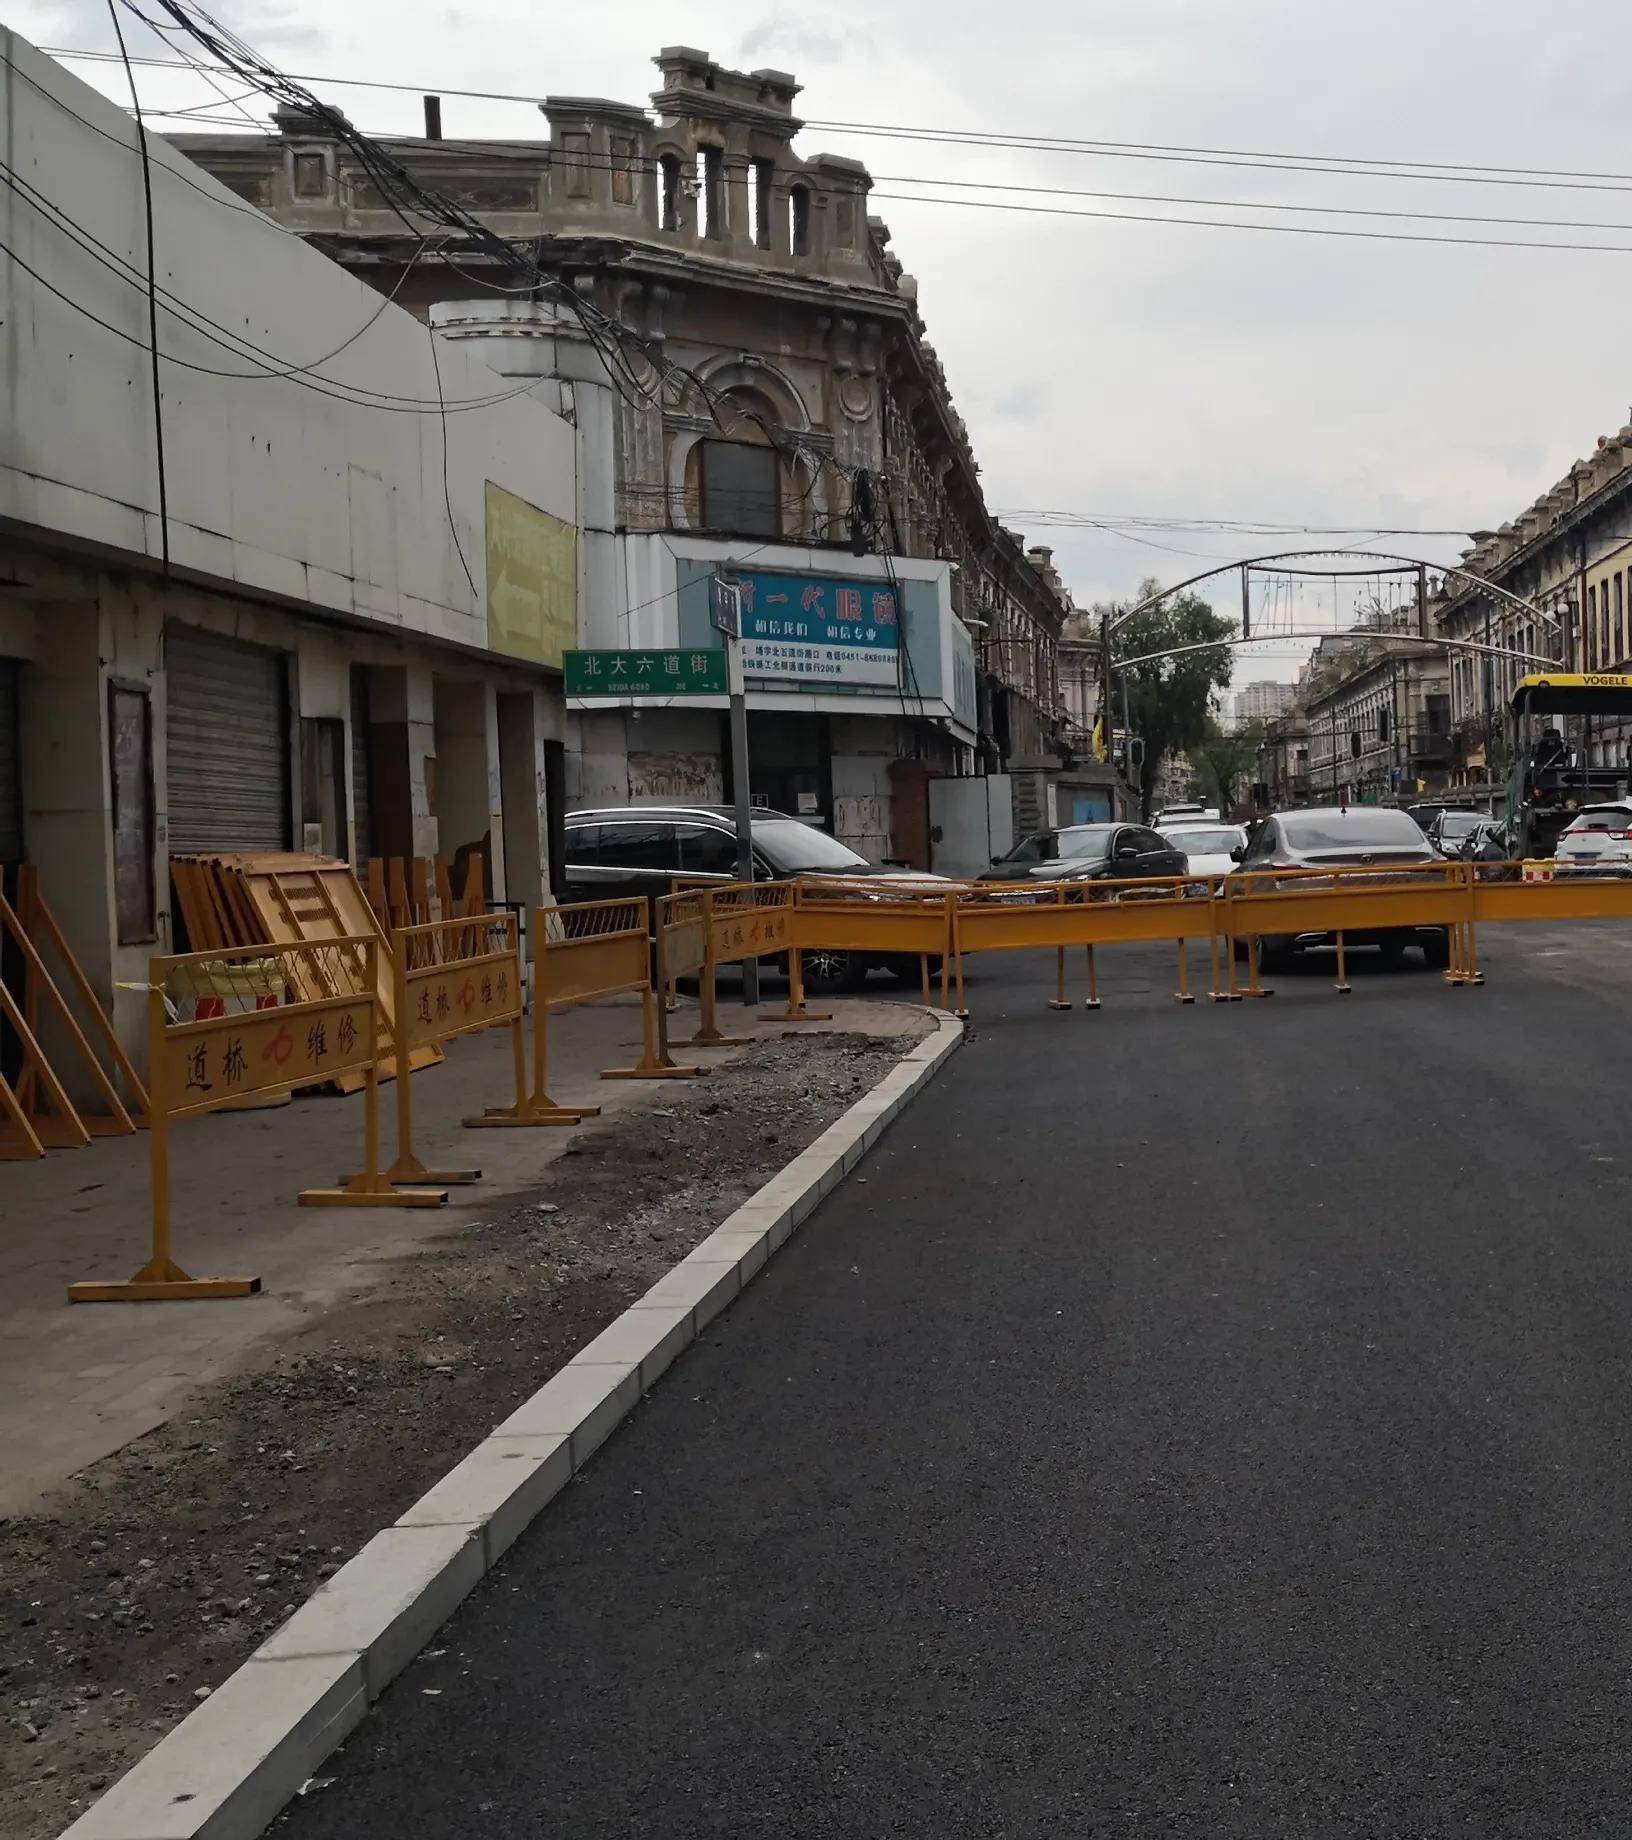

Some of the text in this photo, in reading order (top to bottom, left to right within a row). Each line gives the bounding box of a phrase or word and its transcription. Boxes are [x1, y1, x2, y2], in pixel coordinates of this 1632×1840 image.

[755, 619, 877, 641] 相信我们 相信专业
[584, 655, 708, 675] 北大六道街
[186, 1013, 358, 1091] 道桥 维修
